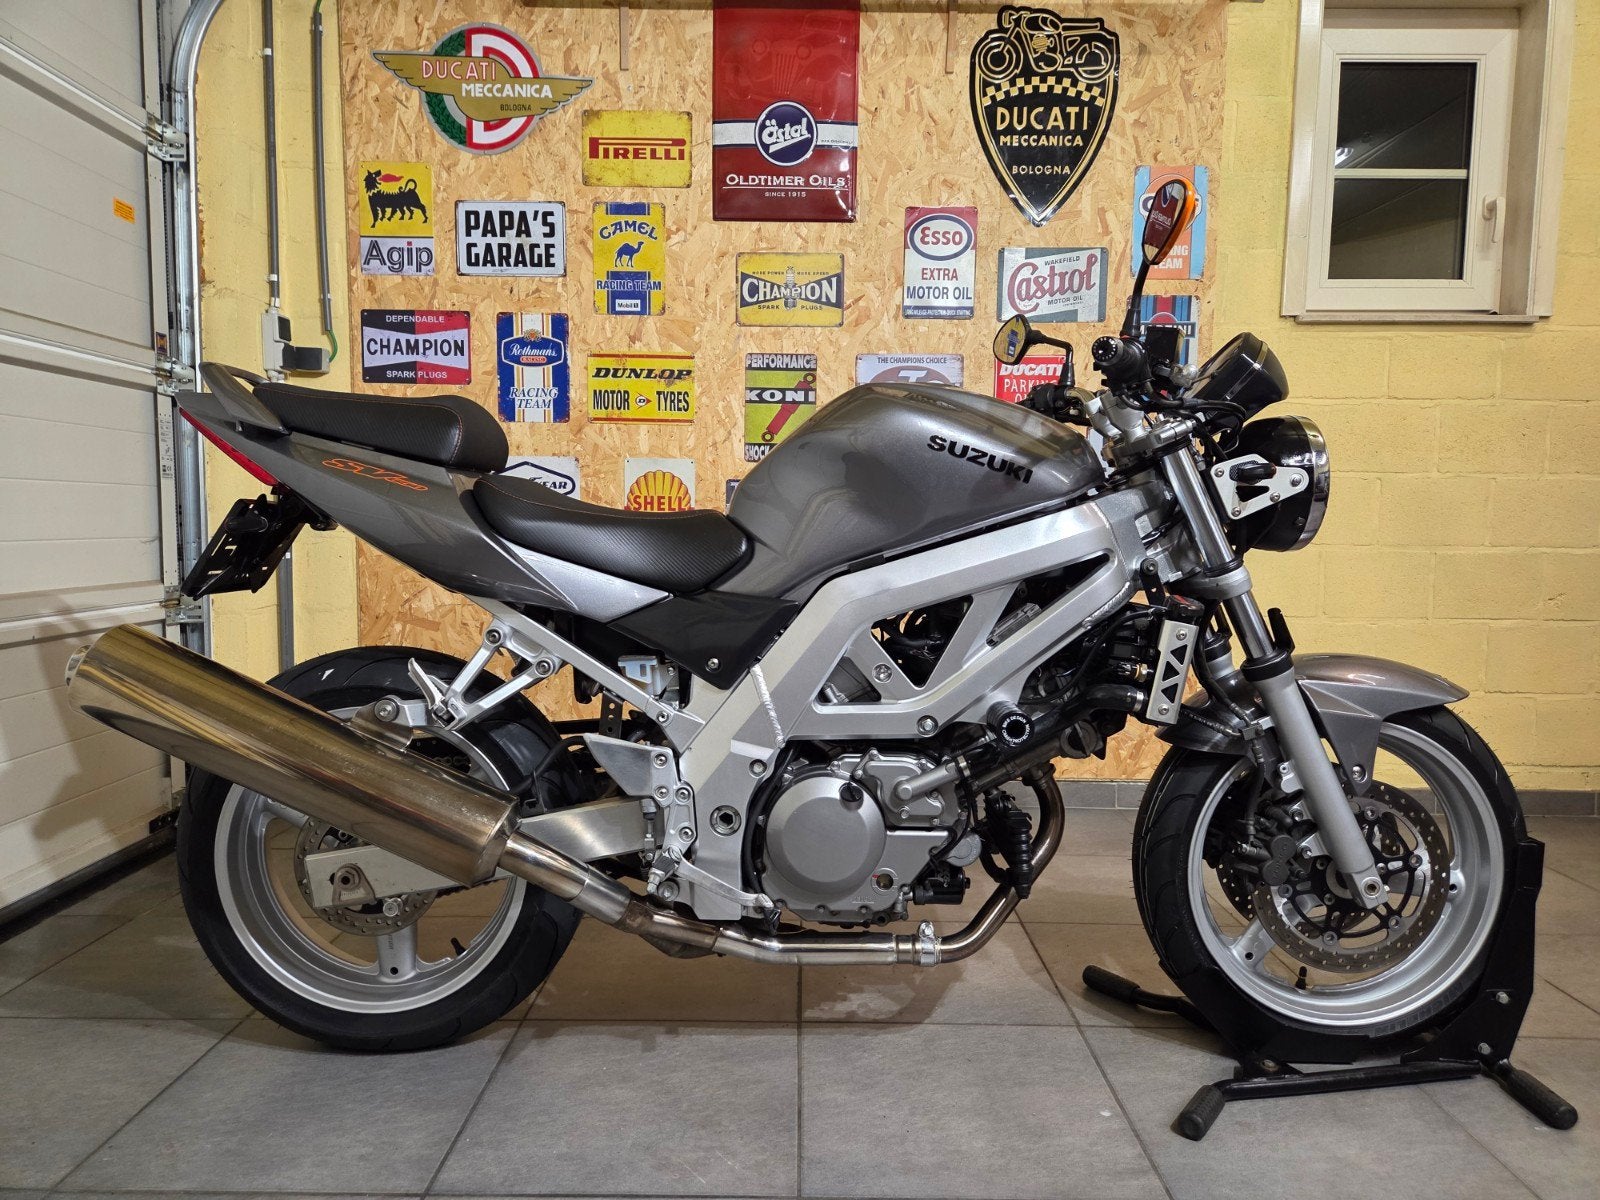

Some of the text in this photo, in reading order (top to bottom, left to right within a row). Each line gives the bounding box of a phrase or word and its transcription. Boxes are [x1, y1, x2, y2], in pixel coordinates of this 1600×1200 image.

[422, 60, 496, 80] DUCATI
[461, 83, 553, 98] MECCANICA
[500, 104, 532, 112] BOLOGNA
[996, 106, 1089, 131] DUCATI
[1000, 135, 1083, 147] MECCANICA
[588, 137, 687, 161] PIRELLI
[1012, 165, 1071, 175] BOLOGNA
[726, 174, 846, 187] OLDTIMER OILS
[465, 210, 556, 238] PAPA'S
[599, 220, 659, 240] CAMEL
[363, 240, 434, 273] Agip
[466, 243, 556, 267] GARAGE
[1168, 245, 1189, 256] ING
[1044, 255, 1081, 266] WAKEFIELD
[921, 267, 959, 281] EXTRA
[596, 280, 662, 292] RACING TEAM
[742, 277, 838, 303] CHAMPION
[1007, 253, 1098, 314] Castrol
[906, 286, 973, 300] MOTOR OIL
[1047, 298, 1071, 306] MOTOR
[385, 315, 445, 323] DEPENDABLE
[366, 338, 465, 357] CHAMPION
[745, 354, 817, 369] PERFORMANCE
[386, 371, 448, 379] SPARK PLUGS
[592, 367, 692, 380] DUNLOP
[999, 363, 1063, 376] DUCATI
[509, 386, 559, 399] RACING
[745, 389, 816, 402] KONI
[517, 399, 552, 409] TEAM
[593, 390, 630, 411] MOTOR
[656, 390, 690, 412] TYRES
[927, 434, 1034, 484] SUZUKI
[633, 494, 687, 512] SHELL
